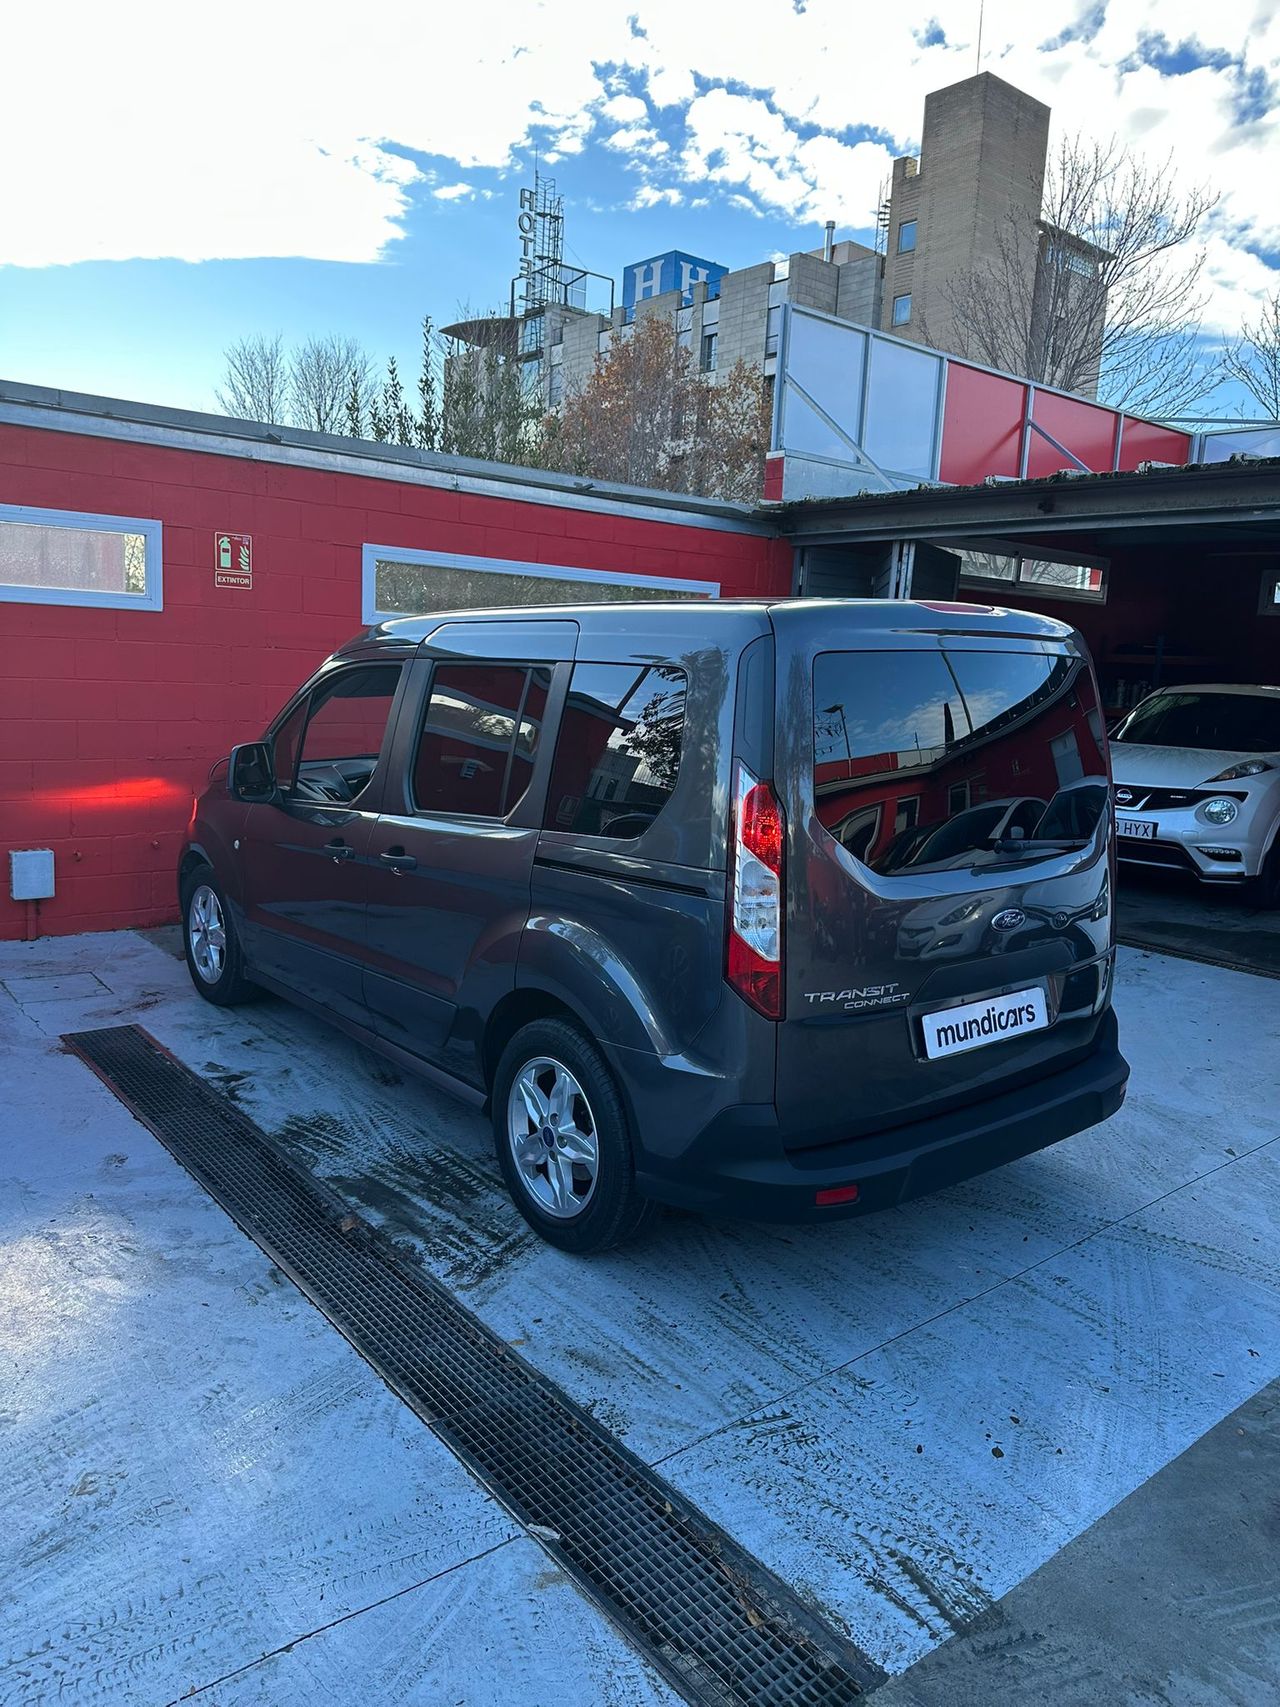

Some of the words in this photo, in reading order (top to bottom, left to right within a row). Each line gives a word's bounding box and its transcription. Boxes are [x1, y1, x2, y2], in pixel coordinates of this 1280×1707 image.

[633, 259, 665, 309] H
[680, 260, 709, 299] H
[217, 576, 250, 585] EXTINTOR
[1123, 822, 1150, 837] HYX
[804, 983, 899, 1003] TRANSIT
[844, 993, 910, 1009] CONNECT
[936, 1003, 1036, 1048] mundicars
